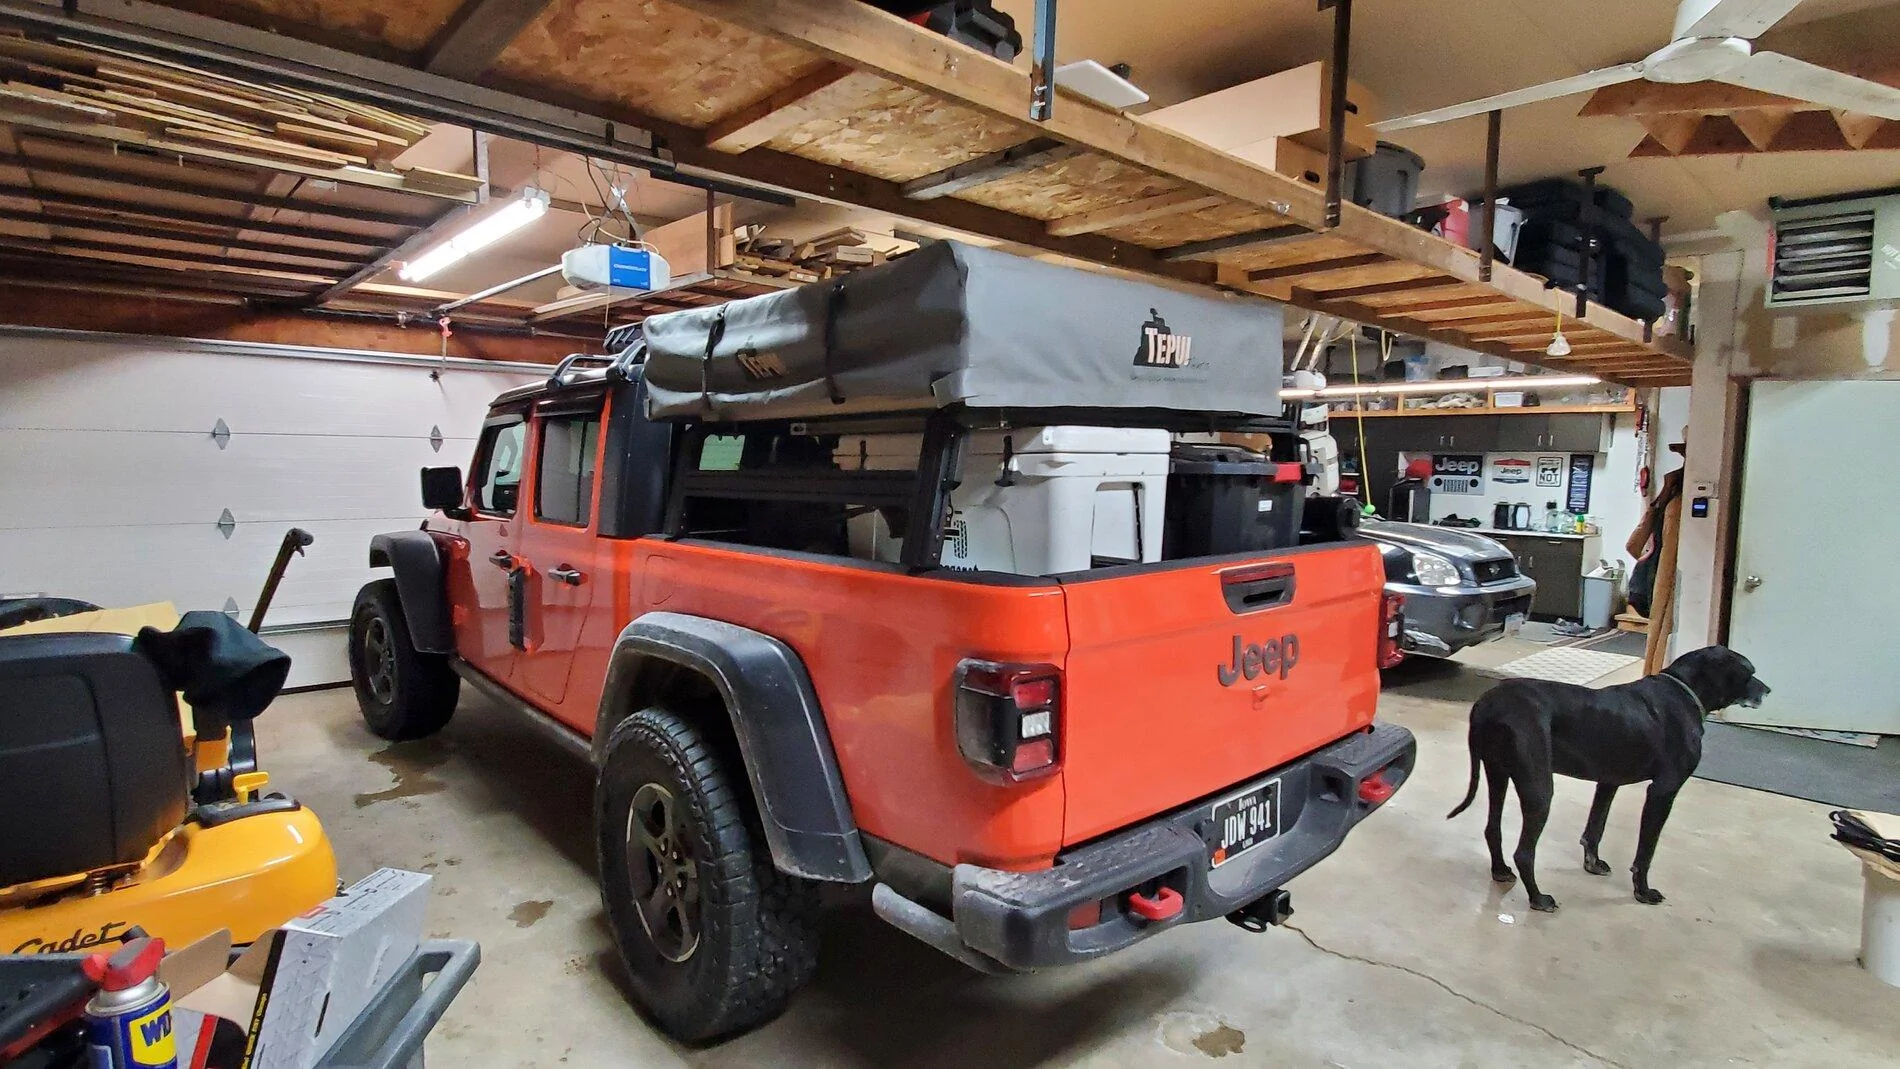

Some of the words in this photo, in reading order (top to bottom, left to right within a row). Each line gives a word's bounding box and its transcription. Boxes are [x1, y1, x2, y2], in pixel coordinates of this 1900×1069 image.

[1435, 457, 1479, 474] Jeep
[1540, 473, 1559, 482] NOT
[1217, 634, 1299, 687] Jeep
[1249, 800, 1272, 836] 941
[12, 921, 126, 954] Cadet
